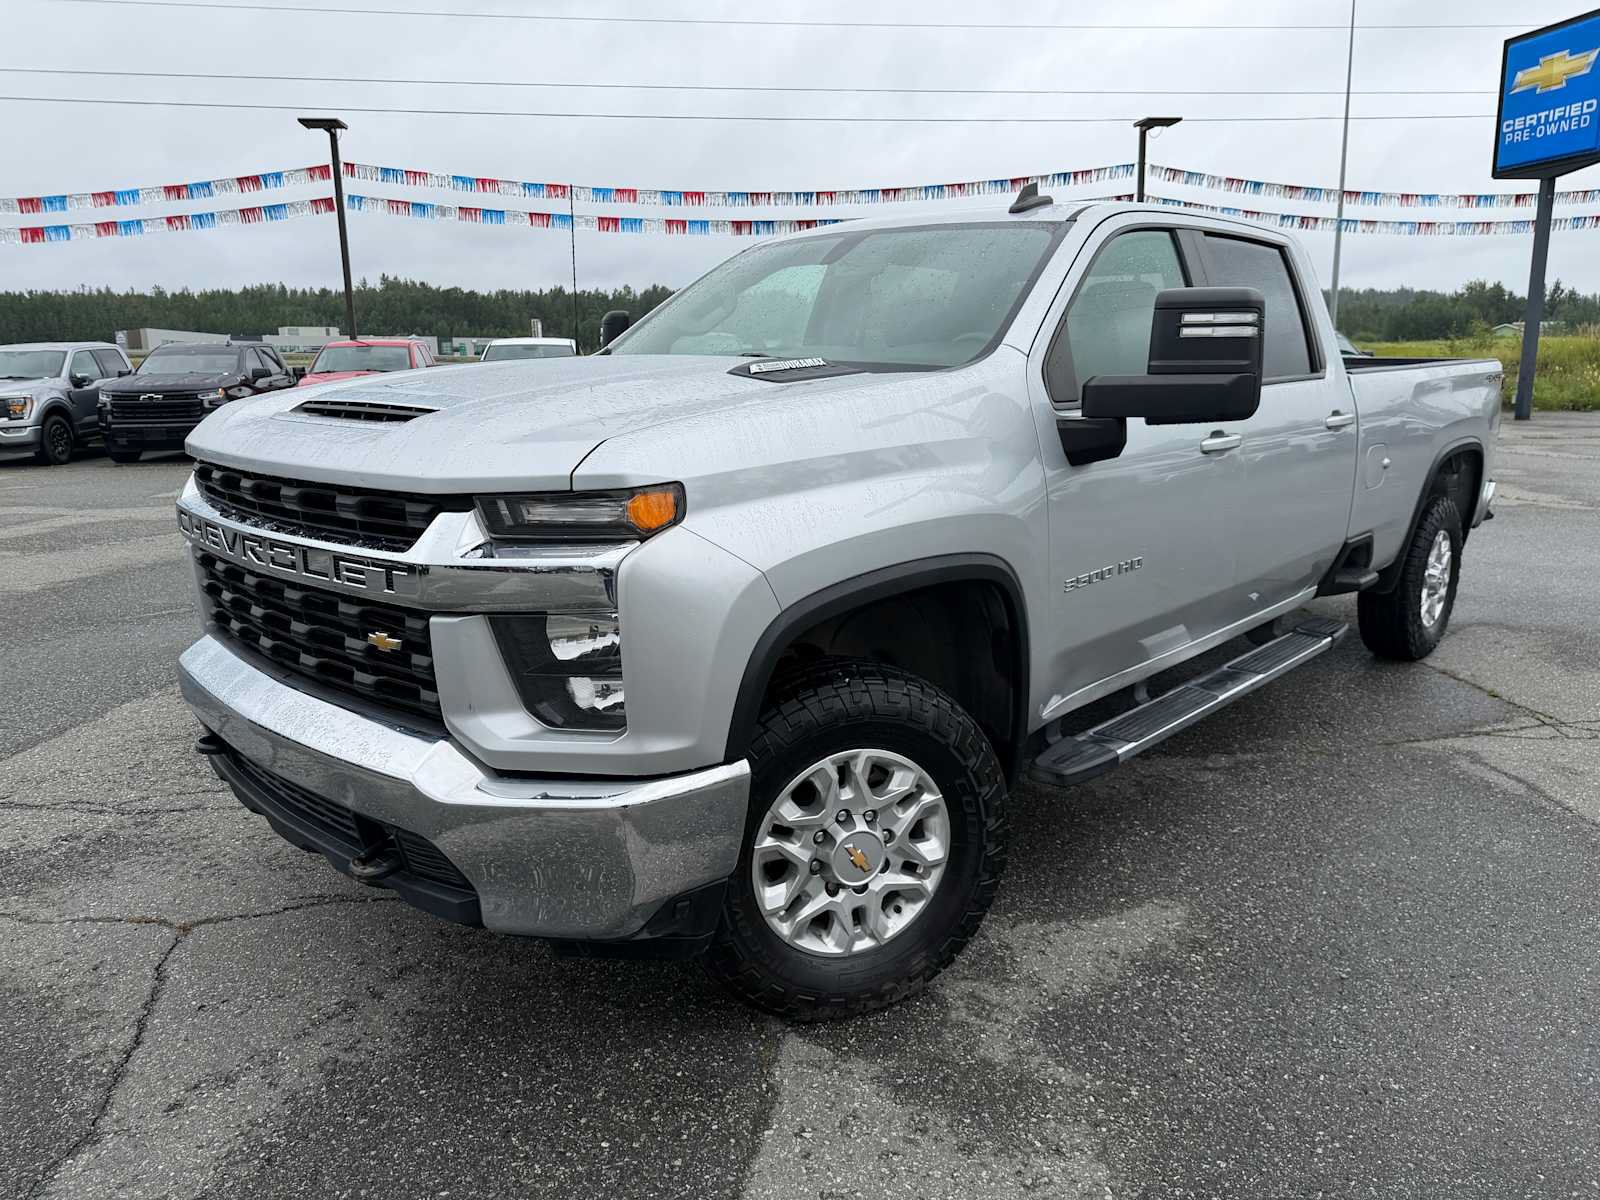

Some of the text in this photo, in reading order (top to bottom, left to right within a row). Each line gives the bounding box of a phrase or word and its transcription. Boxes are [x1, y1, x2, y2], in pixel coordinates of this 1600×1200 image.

[1503, 98, 1597, 133] CERTIFIED
[1505, 115, 1590, 145] PRE-OWNED
[781, 357, 827, 370] DURAMAX
[178, 511, 408, 594] CHEVROLET
[1118, 556, 1143, 575] HD
